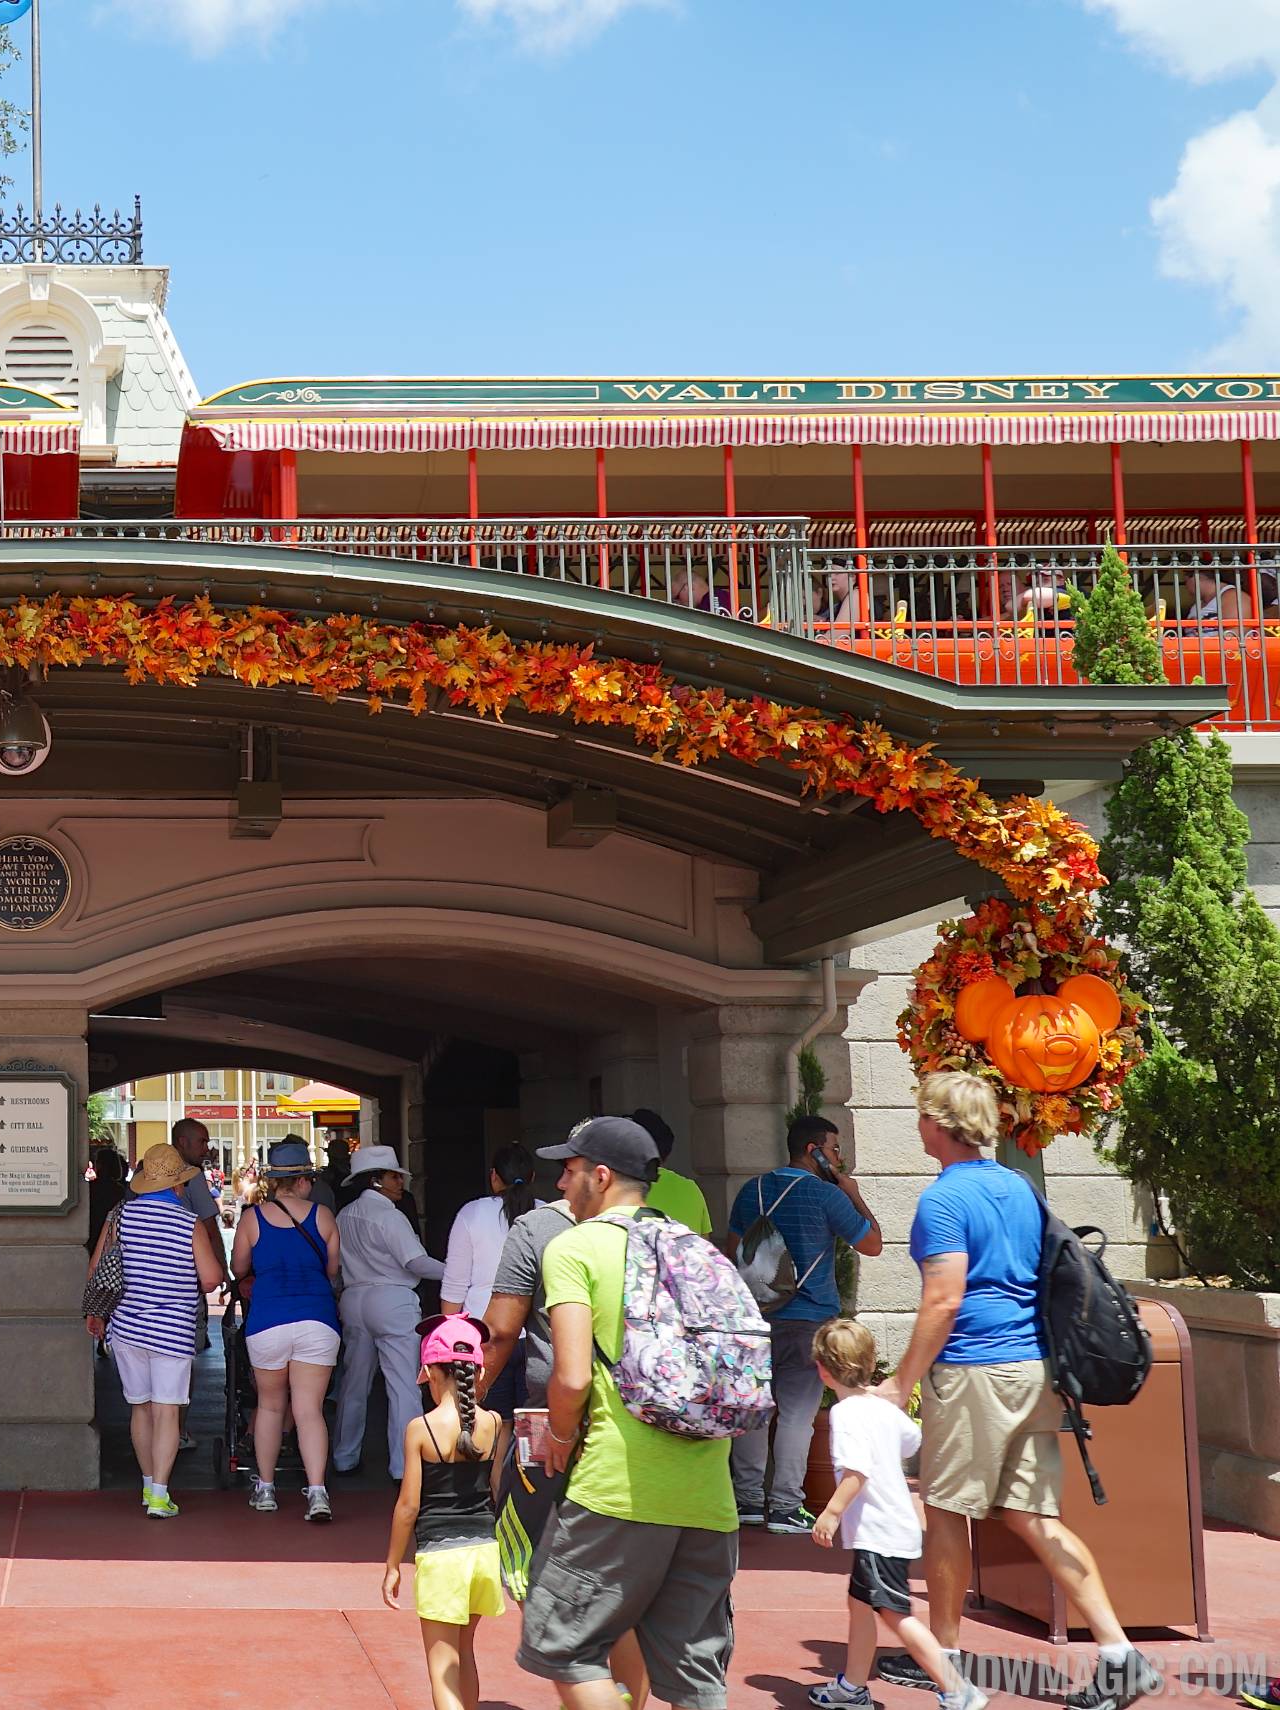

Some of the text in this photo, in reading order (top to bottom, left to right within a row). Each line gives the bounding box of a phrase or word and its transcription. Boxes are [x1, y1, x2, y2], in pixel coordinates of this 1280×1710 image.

[613, 383, 806, 401] WALT
[836, 382, 1120, 401] DISNEY
[28, 855, 49, 863] YOU
[22, 863, 55, 871] TODAY
[6, 878, 47, 886] WORLD
[10, 904, 56, 912] FANTASY
[10, 1097, 50, 1105] RESTROOMS
[10, 1122, 44, 1130] CITY HALL
[10, 1145, 49, 1153] GUIDEMAPS
